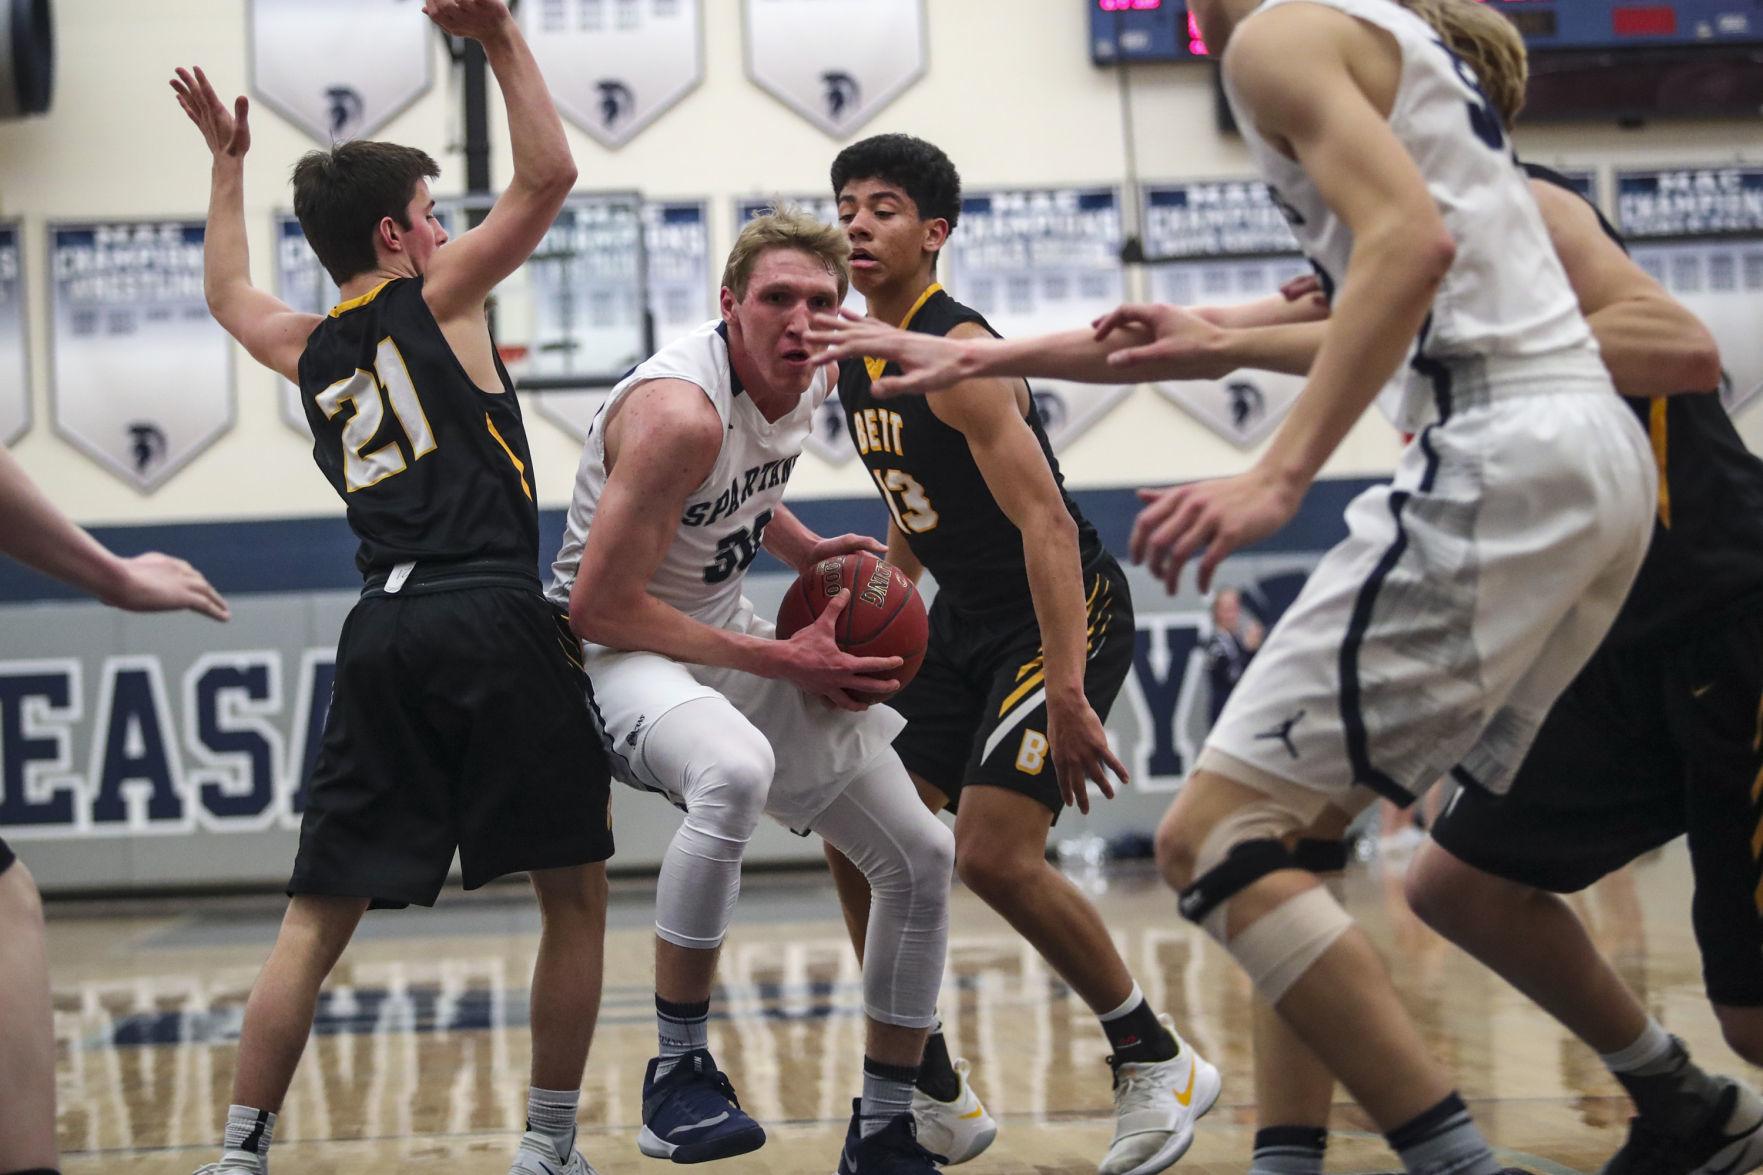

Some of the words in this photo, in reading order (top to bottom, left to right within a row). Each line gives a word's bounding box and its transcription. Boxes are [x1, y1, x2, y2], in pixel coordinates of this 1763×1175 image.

[315, 335, 438, 493] 21
[854, 408, 904, 456] BETT
[873, 468, 939, 535] 13
[1016, 728, 1049, 775] B
